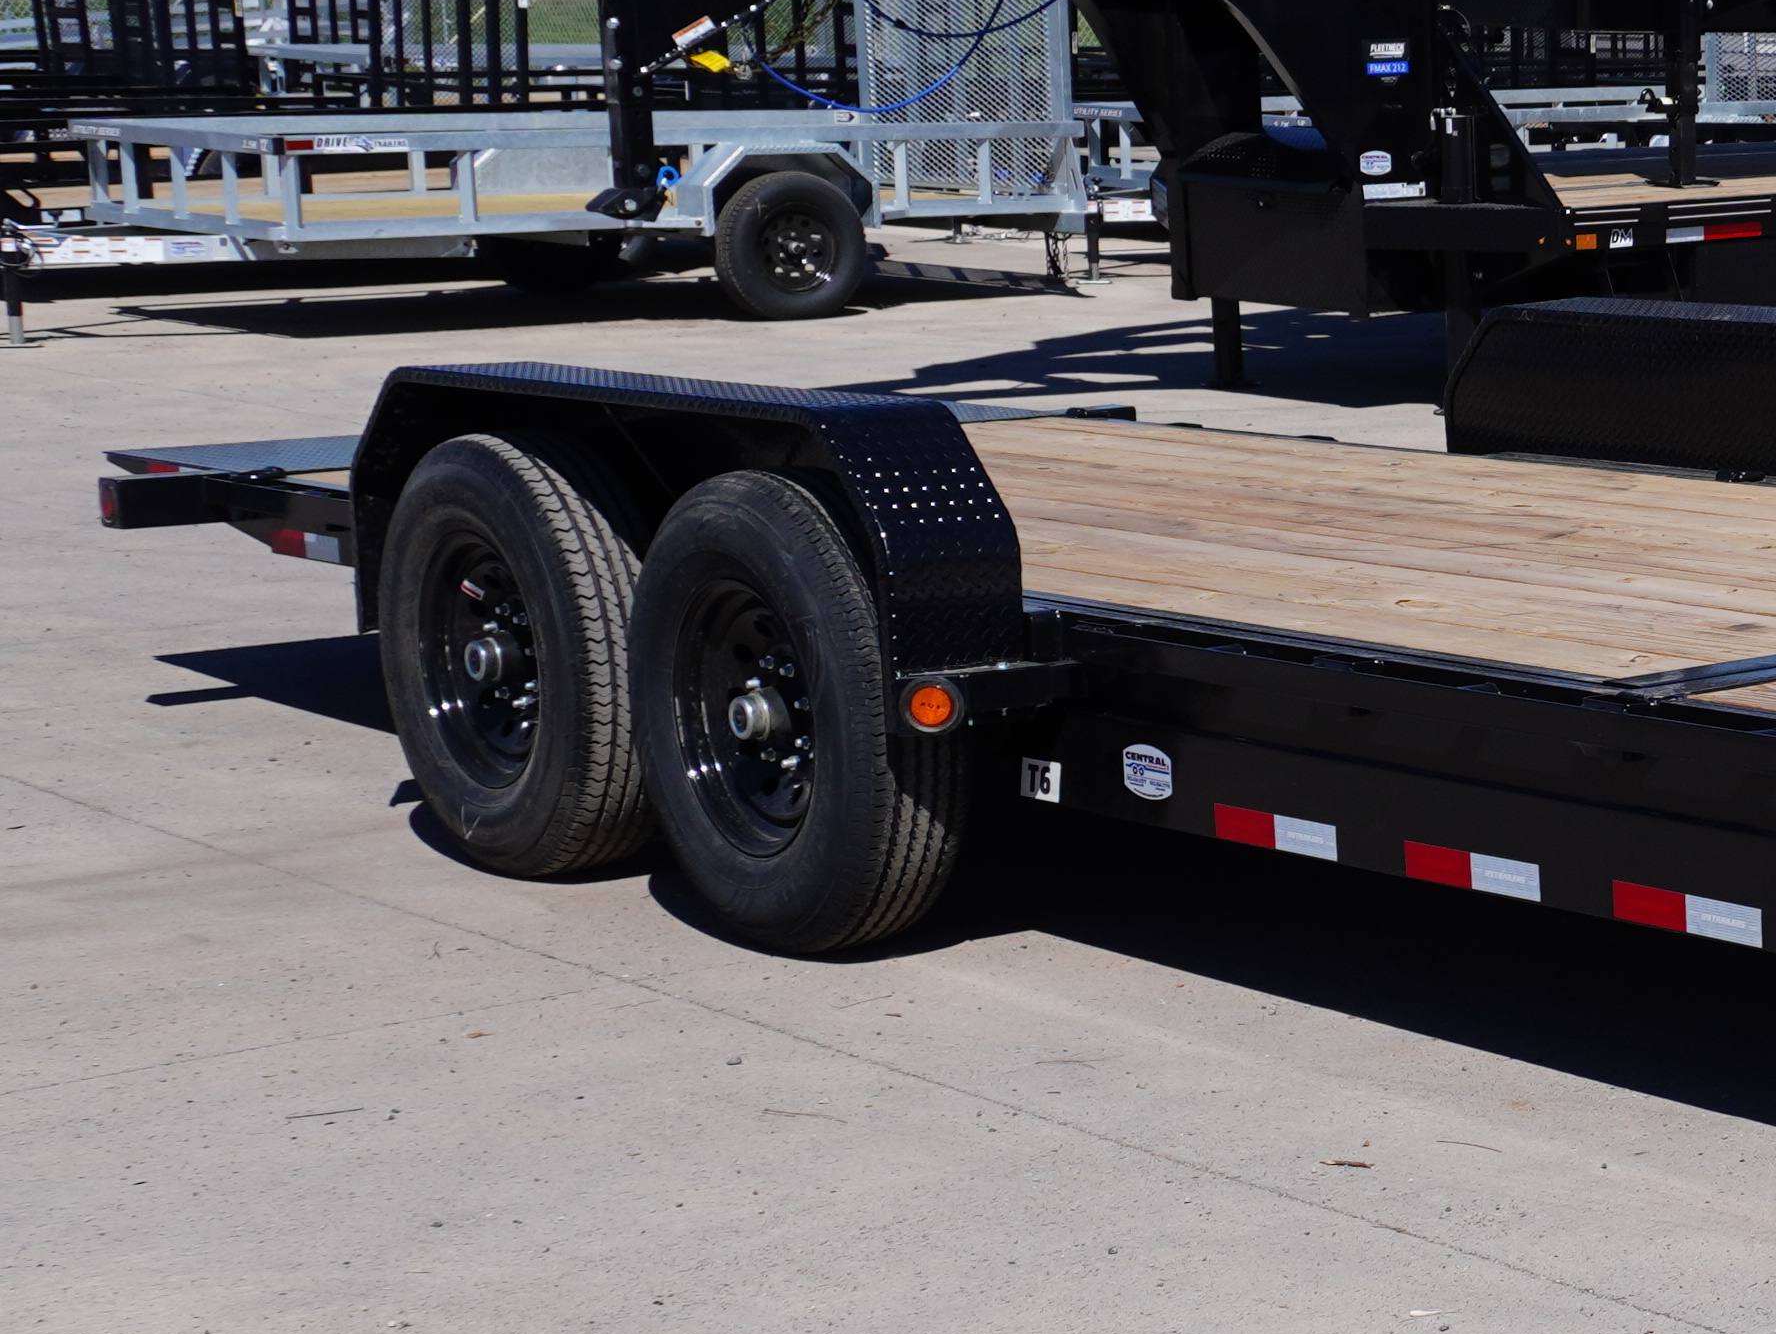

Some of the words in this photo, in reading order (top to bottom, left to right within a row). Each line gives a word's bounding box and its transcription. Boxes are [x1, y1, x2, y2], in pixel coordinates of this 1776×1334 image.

[1392, 62, 1406, 73] 212
[316, 137, 348, 148] DRIVE
[1125, 751, 1167, 766] CENTRAL
[1027, 763, 1052, 795] T6
